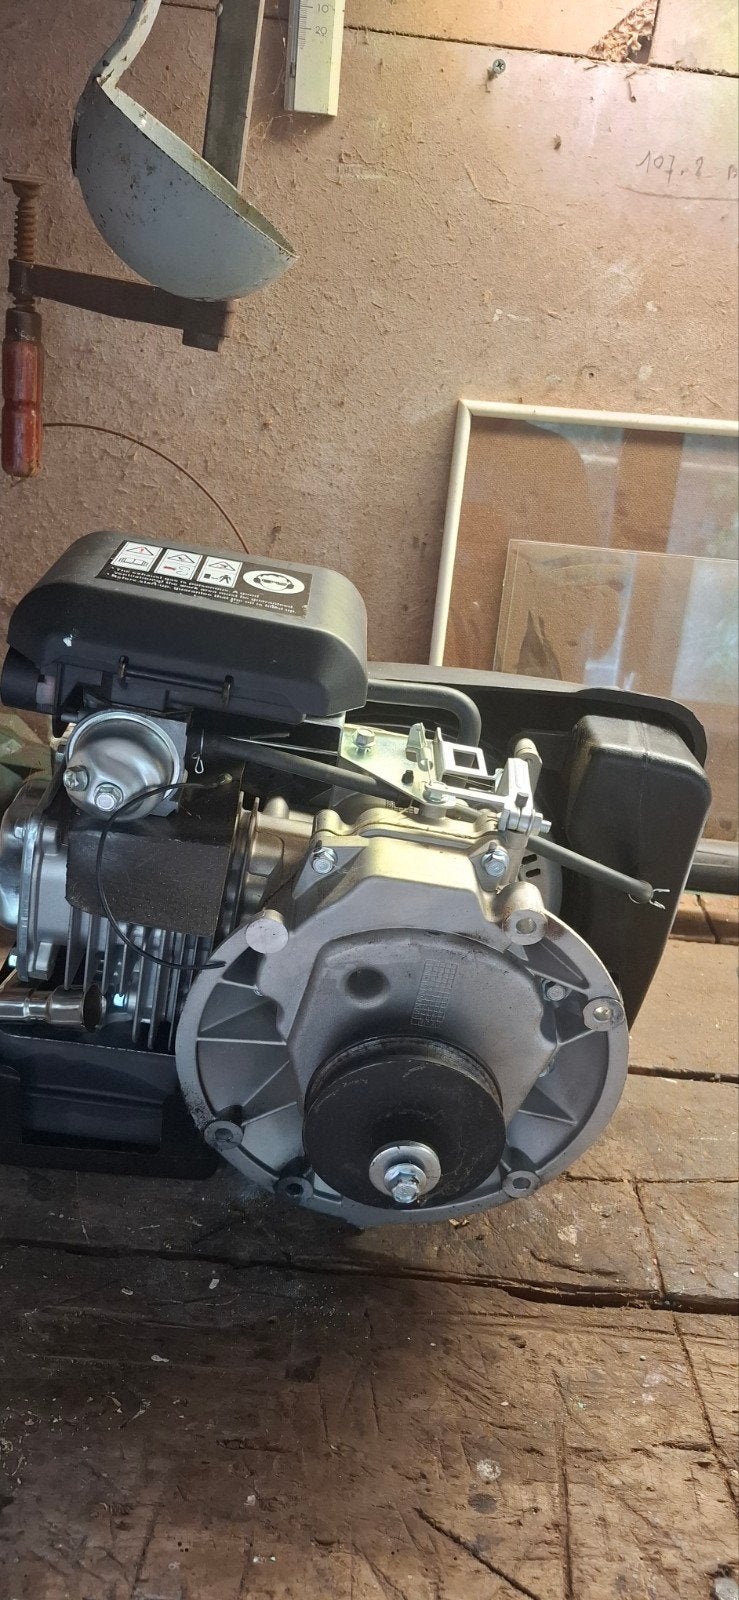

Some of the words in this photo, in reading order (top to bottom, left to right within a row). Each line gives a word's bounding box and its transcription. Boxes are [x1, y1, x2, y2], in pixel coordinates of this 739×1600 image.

[317, 3, 329, 14] 10
[315, 25, 328, 36] 20
[111, 573, 137, 583] Before
